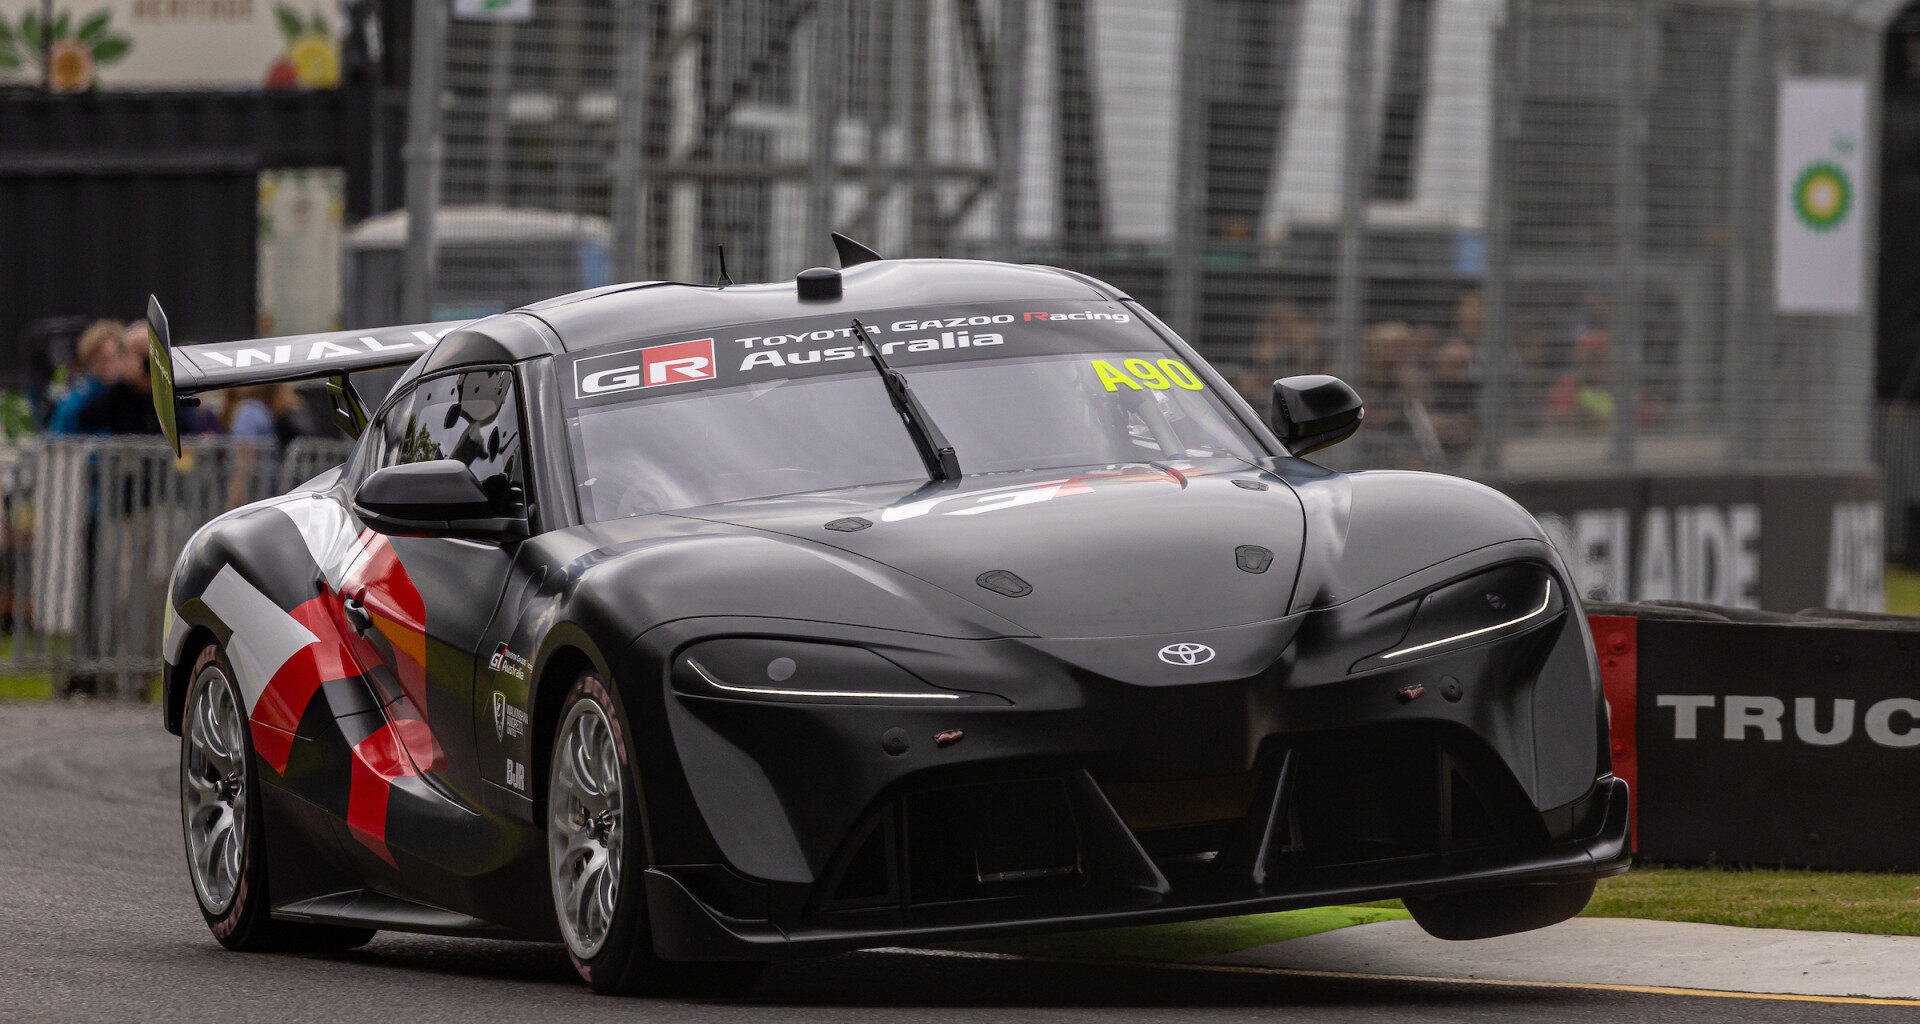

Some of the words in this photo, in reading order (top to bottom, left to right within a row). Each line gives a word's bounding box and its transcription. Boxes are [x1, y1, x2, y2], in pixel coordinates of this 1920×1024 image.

[735, 324, 881, 349] TOYOTA
[891, 314, 1015, 333] GAZOO
[1022, 310, 1130, 323] Racing
[739, 330, 1004, 372] Australia
[582, 355, 709, 394] GR
[1091, 358, 1204, 392] A90
[1656, 694, 1920, 747] TRUC
[507, 758, 525, 791] BJR
